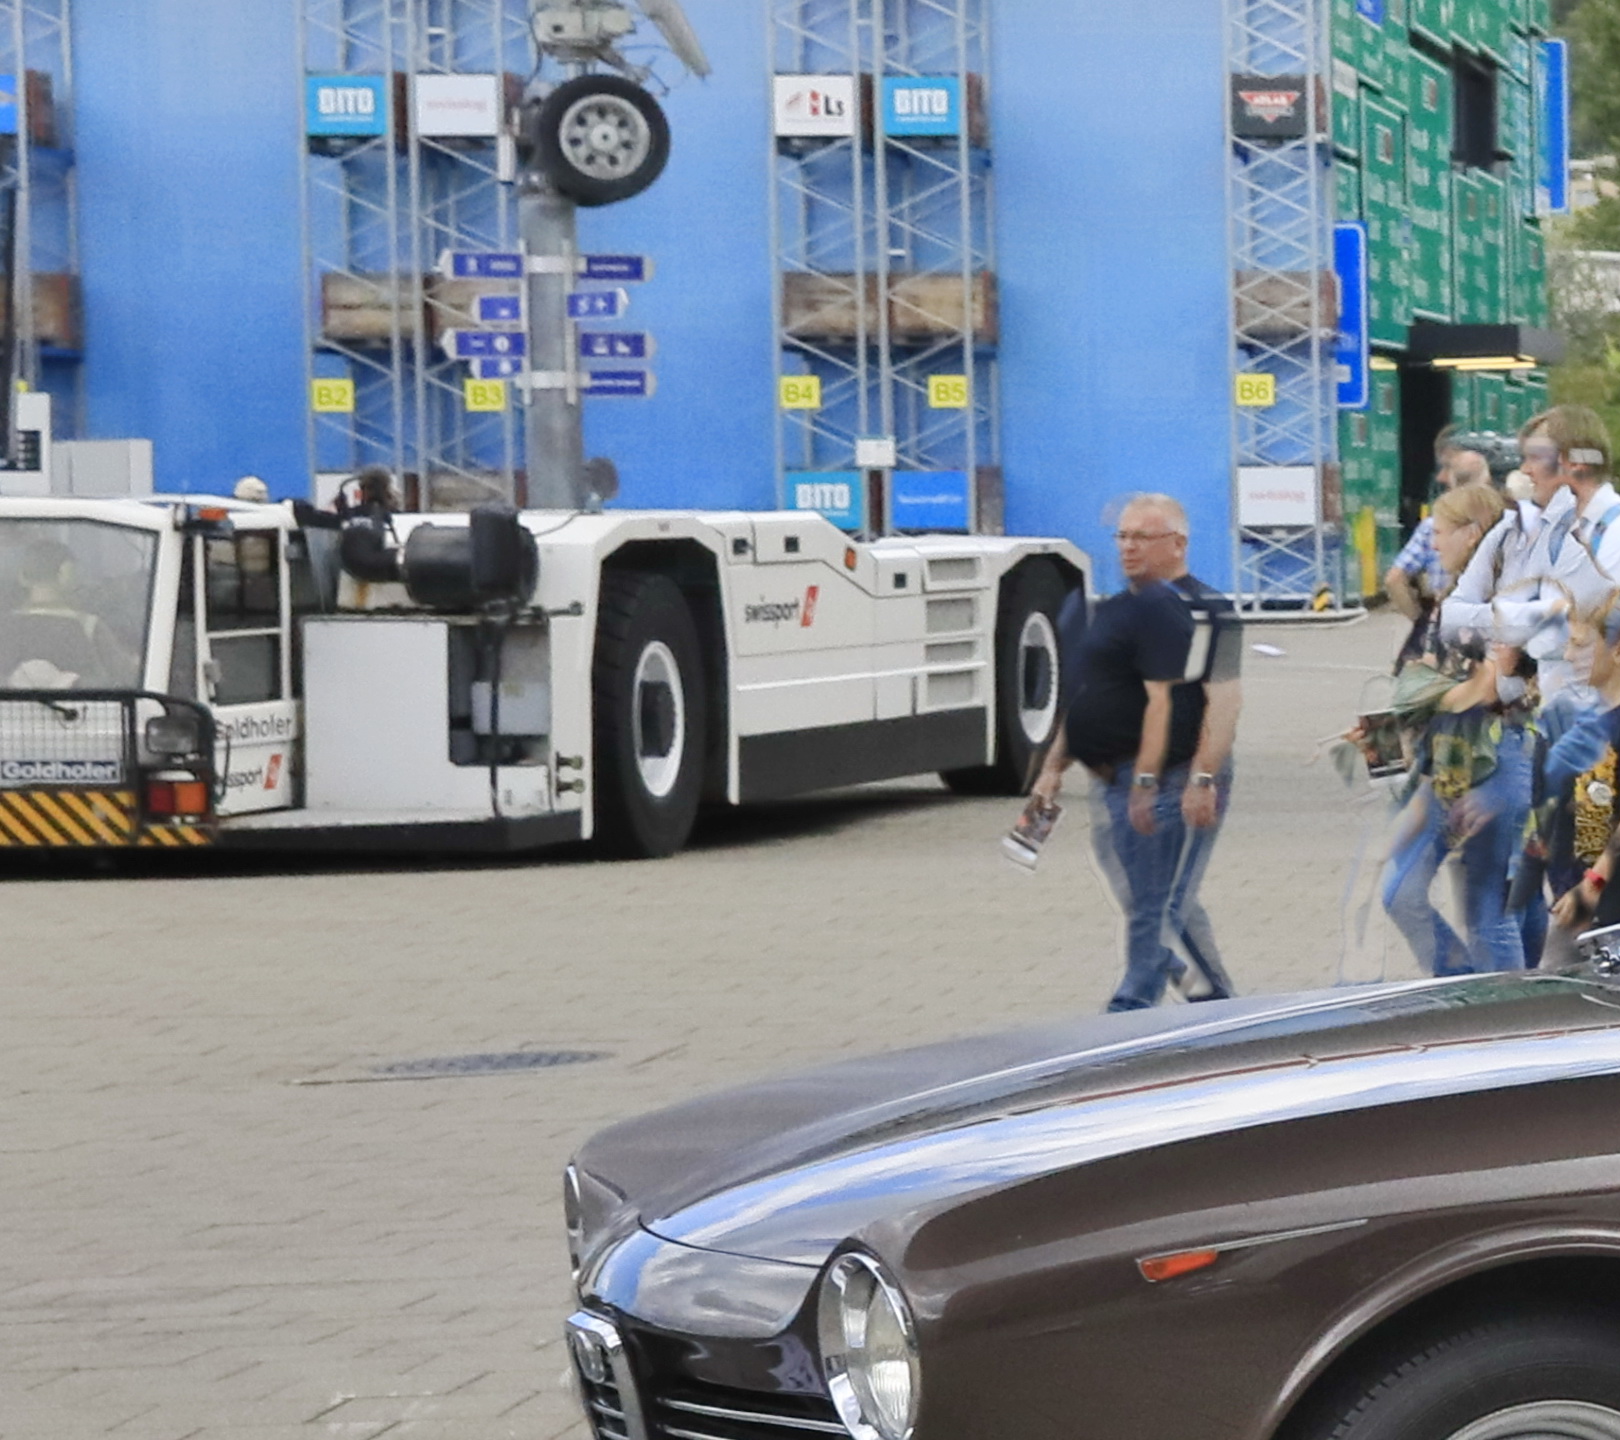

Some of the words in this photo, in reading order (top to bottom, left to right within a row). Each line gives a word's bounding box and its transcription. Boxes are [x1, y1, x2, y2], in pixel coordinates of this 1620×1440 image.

[317, 386, 348, 406] B2
[472, 385, 503, 406] B3
[783, 383, 814, 404] B4
[934, 382, 966, 403] B5
[1239, 381, 1270, 401] B6
[2, 760, 119, 781] Goldhofer
